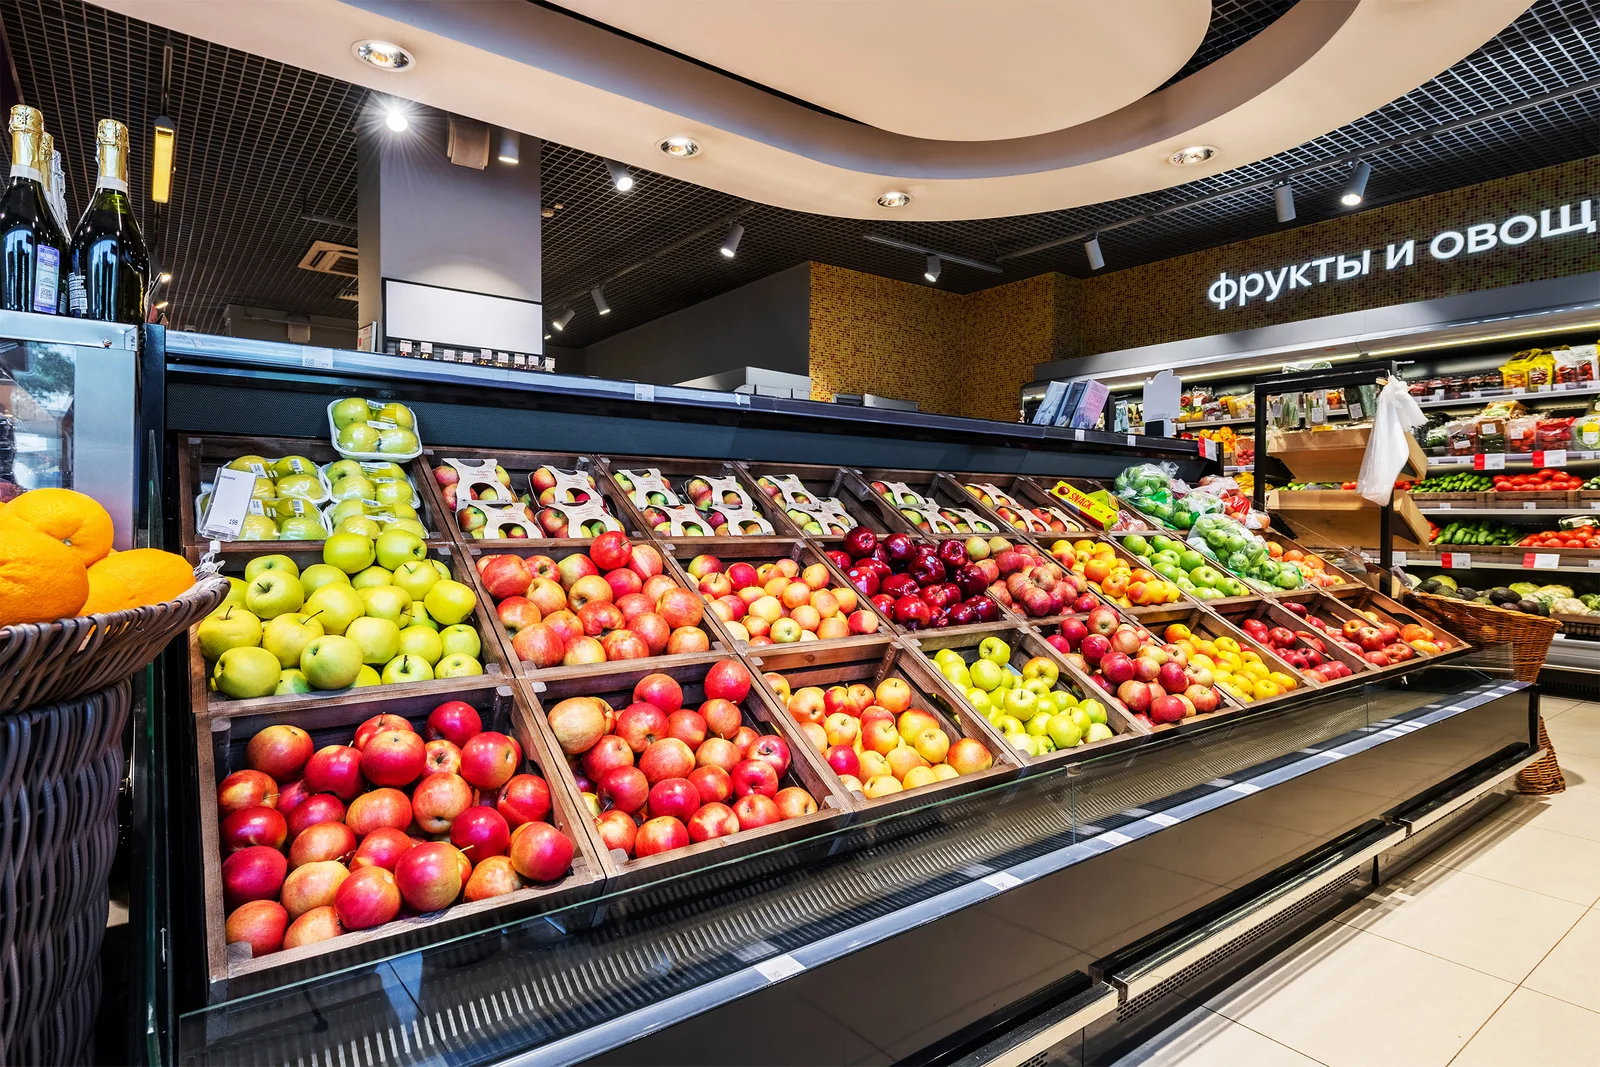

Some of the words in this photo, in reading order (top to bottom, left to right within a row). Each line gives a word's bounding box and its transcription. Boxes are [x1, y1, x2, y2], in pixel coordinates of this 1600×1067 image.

[1207, 249, 1371, 310] фрукты
[1385, 239, 1415, 270] и
[1069, 492, 1095, 509] SNACK
